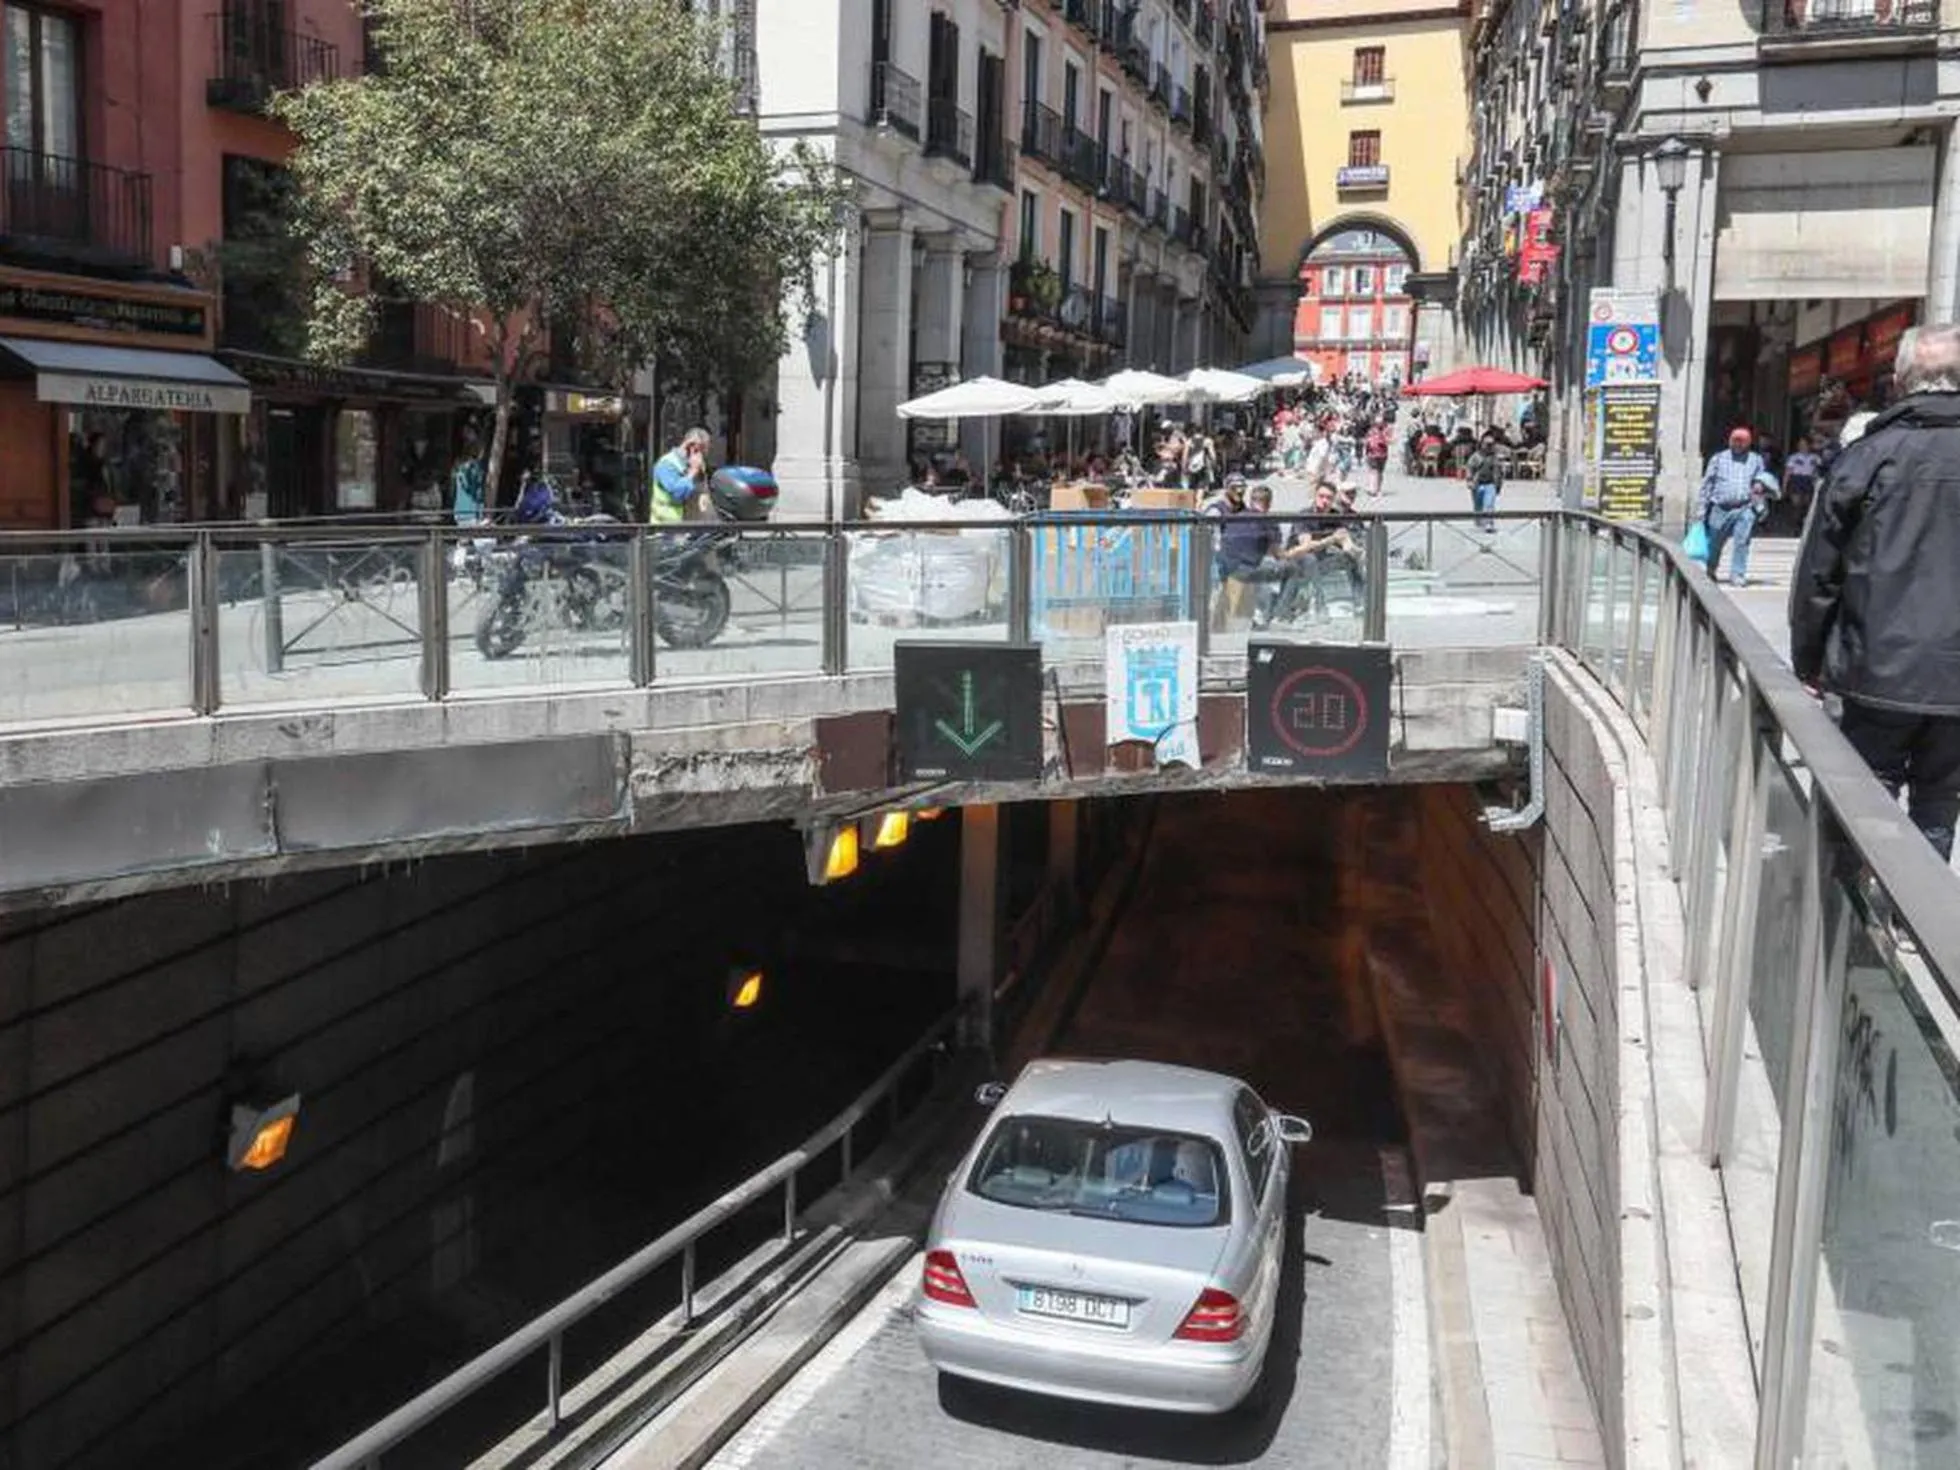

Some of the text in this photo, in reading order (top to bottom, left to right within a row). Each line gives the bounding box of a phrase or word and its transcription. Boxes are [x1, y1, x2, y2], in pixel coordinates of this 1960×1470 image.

[84, 383, 213, 409] ALPARGATERIA
[1293, 692, 1345, 730] 20
[1034, 1287, 1077, 1313] 8198
